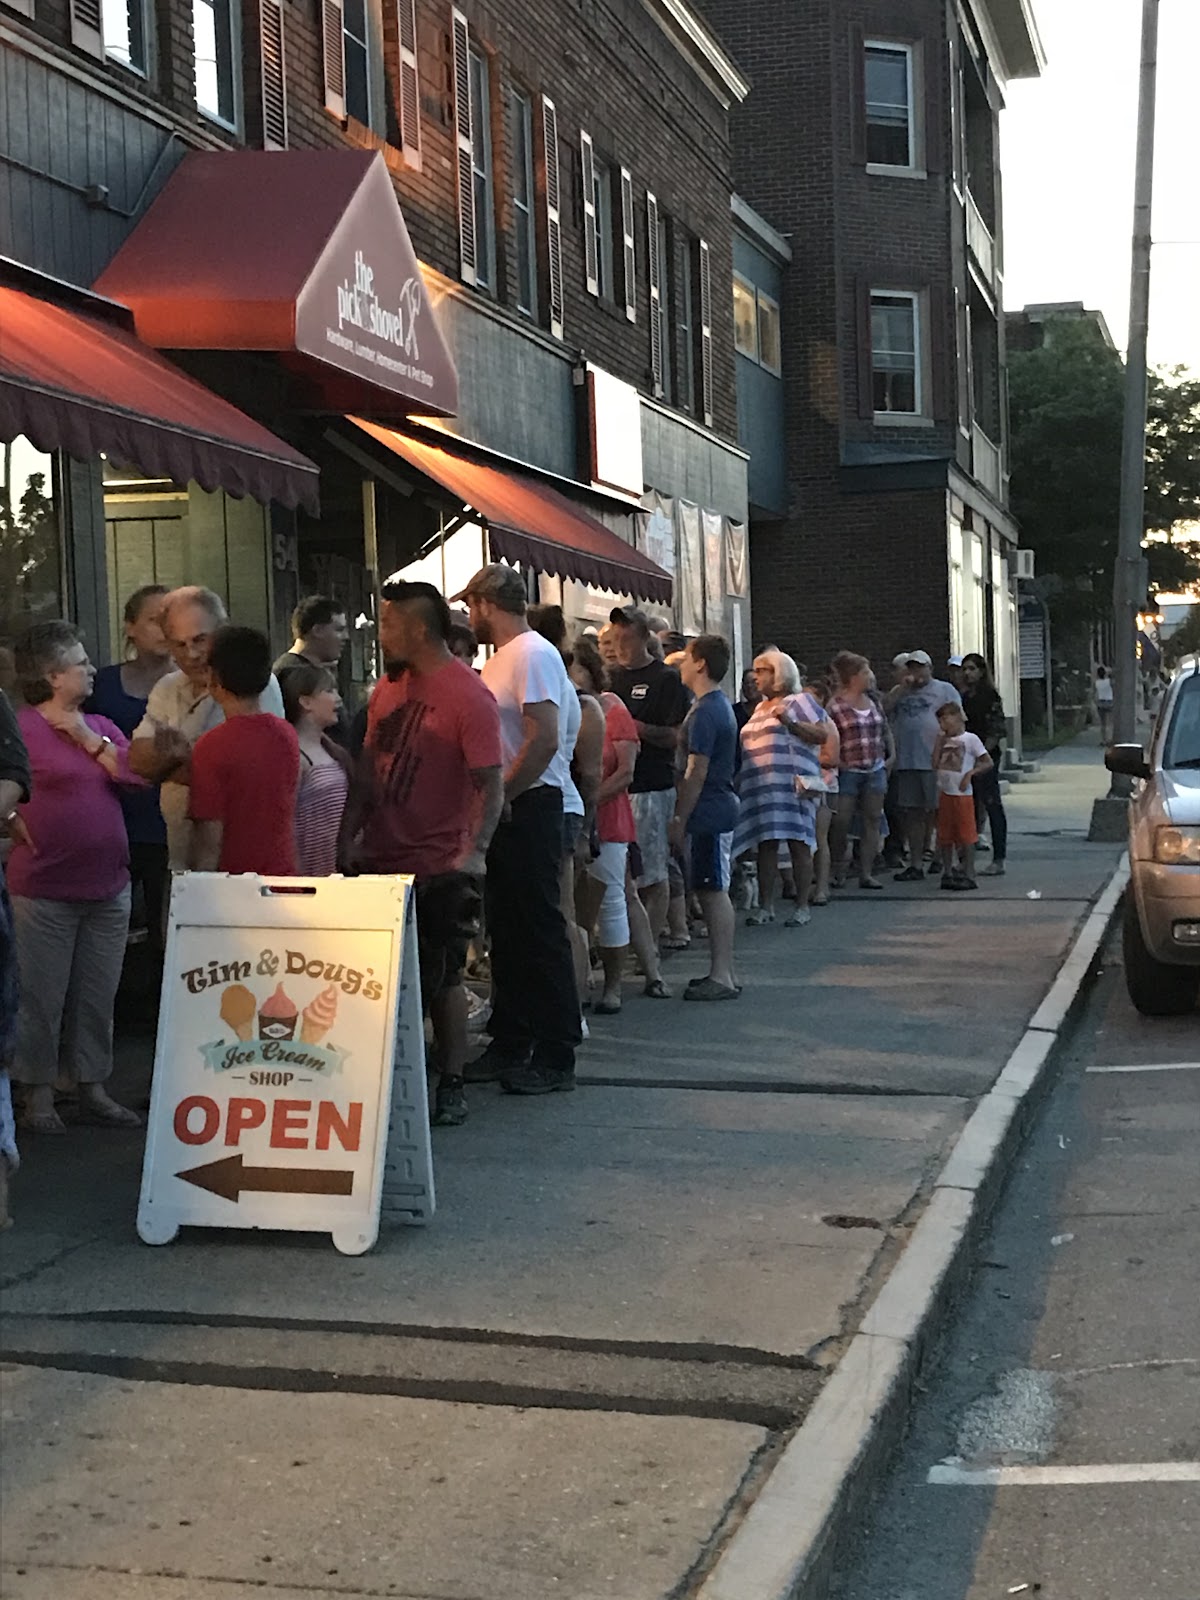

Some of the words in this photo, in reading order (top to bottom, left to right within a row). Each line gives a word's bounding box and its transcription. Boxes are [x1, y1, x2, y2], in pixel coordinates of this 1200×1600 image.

[355, 250, 374, 298] the
[337, 278, 362, 331] pick
[370, 295, 404, 348] shovel
[180, 959, 252, 994] Tim
[256, 948, 280, 977] &
[284, 949, 384, 1001] Doug's
[221, 1047, 256, 1070] Ice
[259, 1041, 327, 1072] Cream
[249, 1071, 294, 1087] SHOP
[173, 1094, 363, 1152] OPEN
